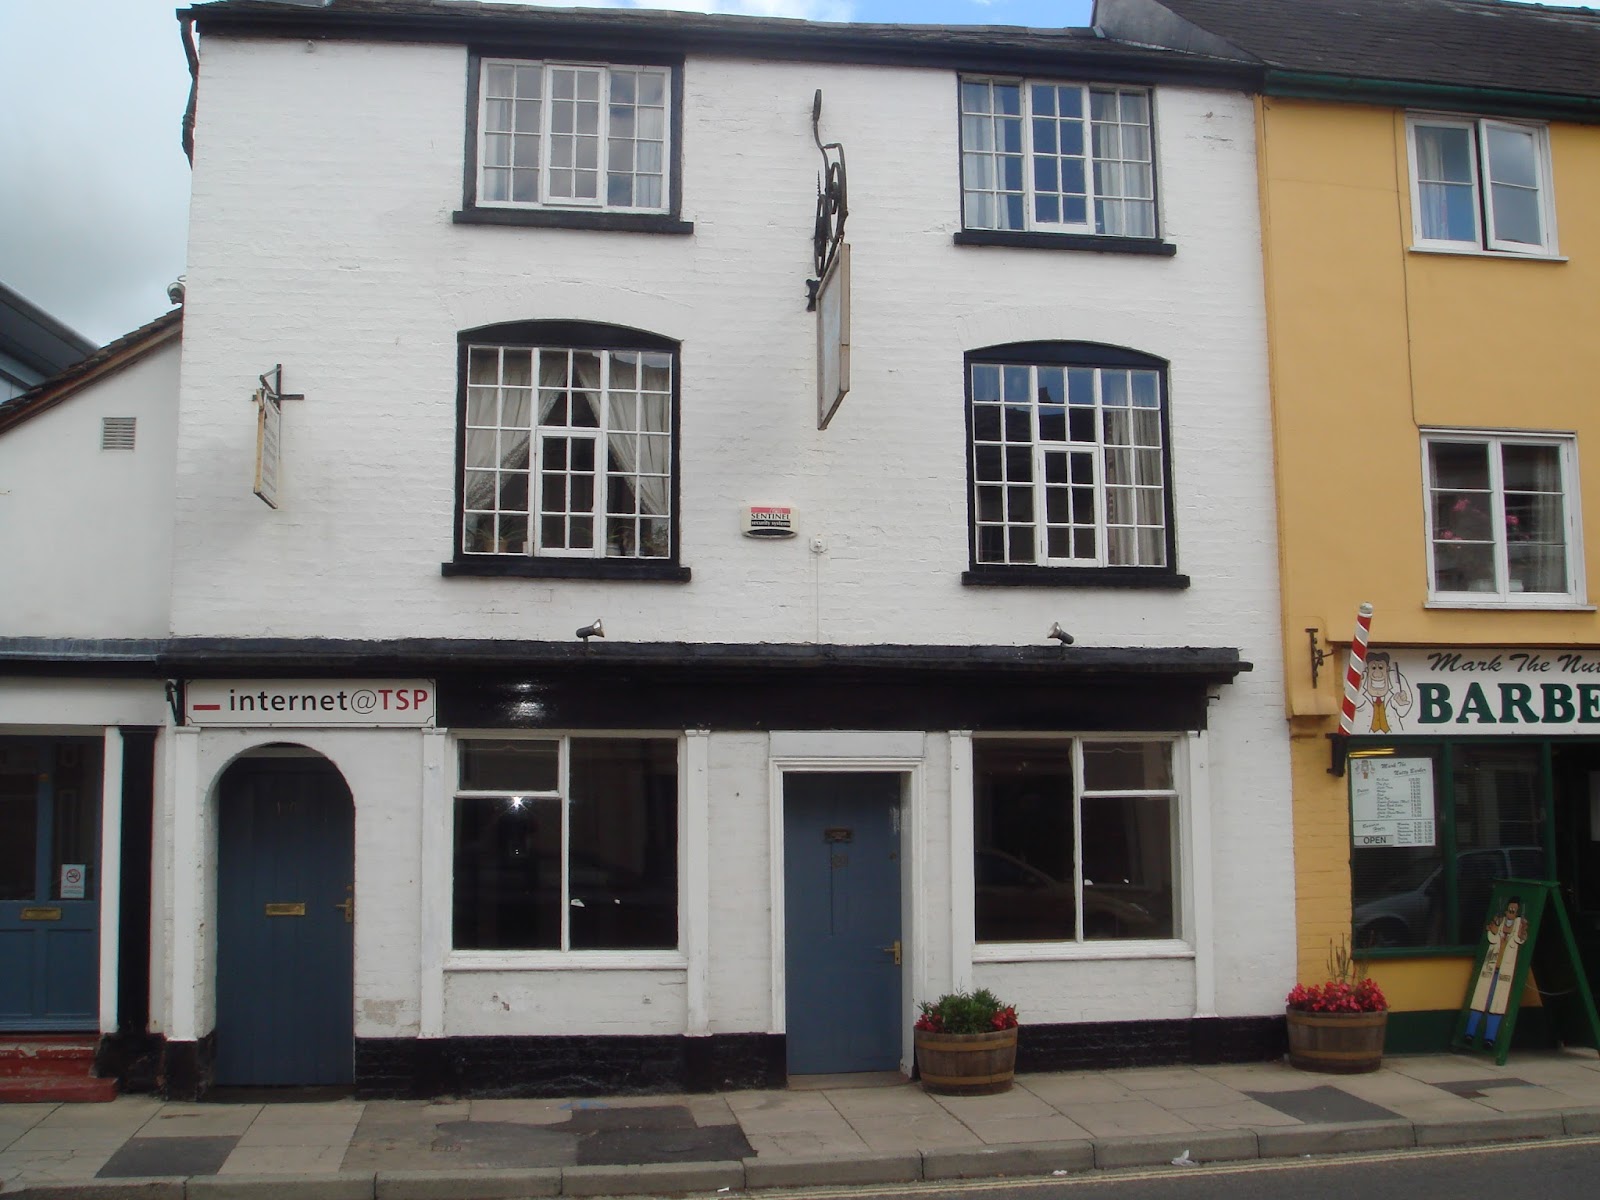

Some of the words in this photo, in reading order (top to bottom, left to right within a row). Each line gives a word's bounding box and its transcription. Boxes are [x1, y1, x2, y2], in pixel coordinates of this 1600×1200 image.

[1426, 652, 1503, 672] Mark
[1509, 653, 1551, 673] The
[230, 689, 428, 715] internet@TSP
[1416, 682, 1600, 724] BARBE
[1363, 836, 1387, 844] OPEN
